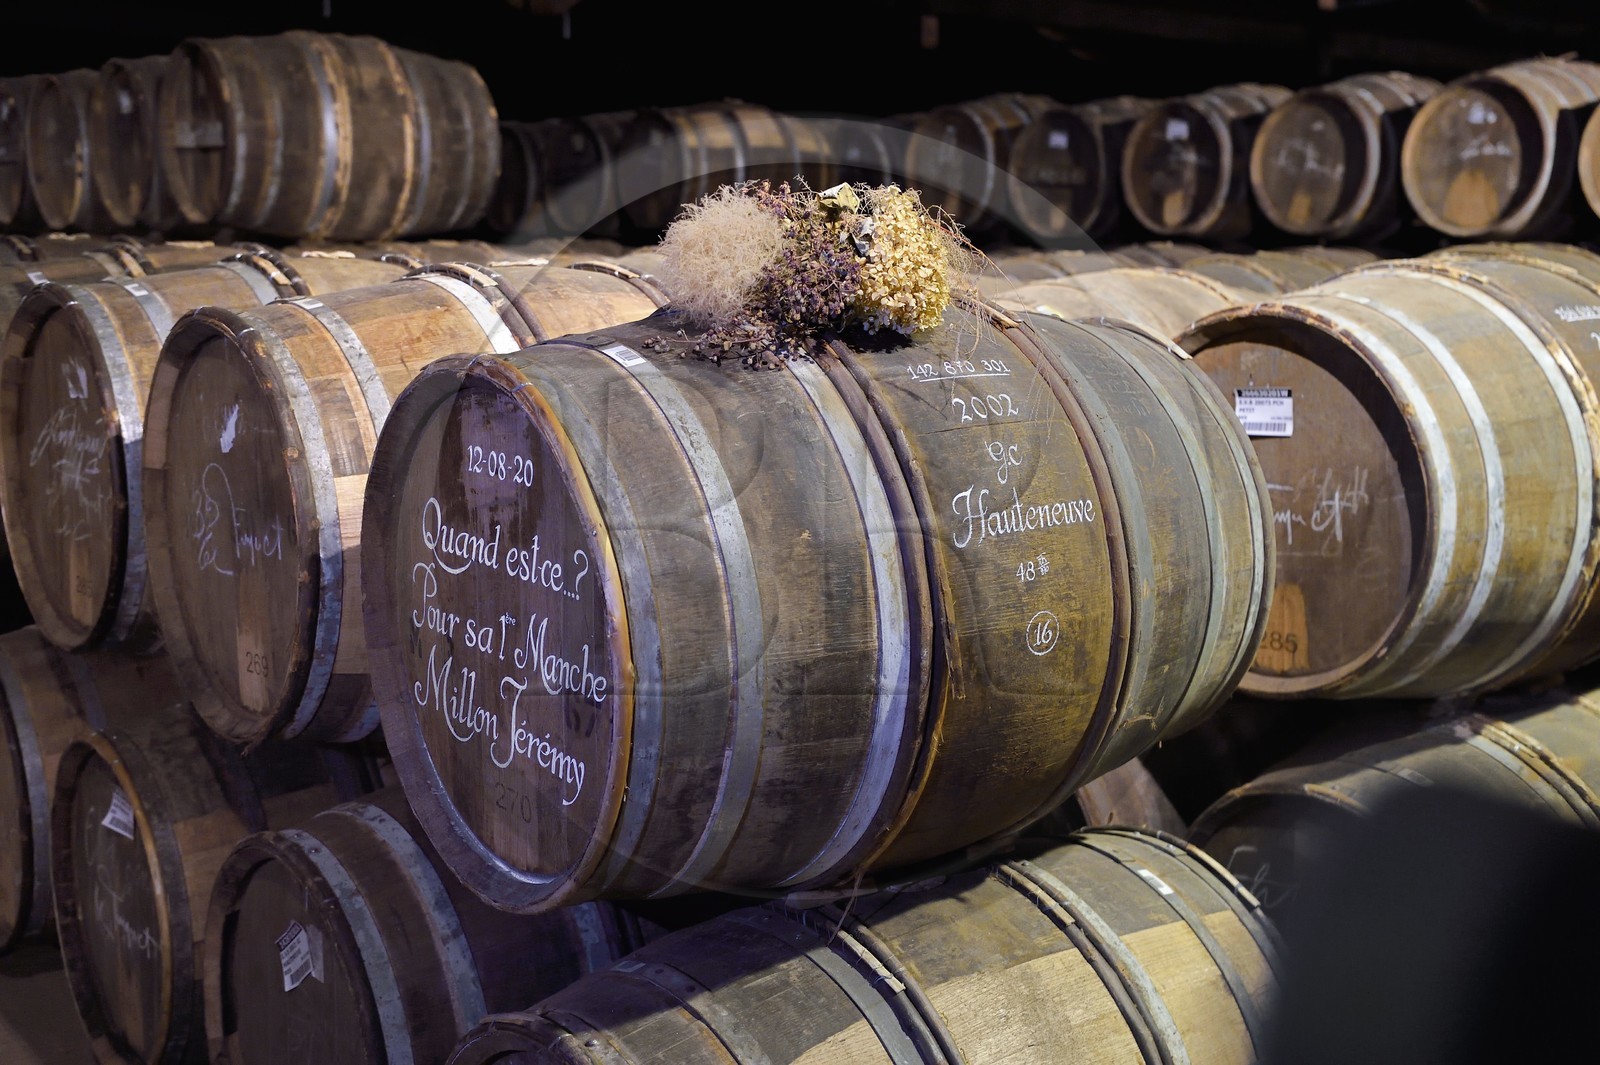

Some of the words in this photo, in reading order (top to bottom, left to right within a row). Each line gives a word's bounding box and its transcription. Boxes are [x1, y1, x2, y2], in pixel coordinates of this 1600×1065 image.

[907, 363, 938, 380] 142
[981, 359, 1011, 373] 301
[952, 393, 1019, 423] 2002
[467, 445, 534, 487] 12-08-20
[422, 497, 499, 574] Quand
[952, 484, 1096, 548] Hauteneuve
[412, 562, 460, 639] Pour
[464, 618, 494, 654] sa
[514, 613, 607, 702] Manche
[1033, 619, 1052, 646] 16
[246, 651, 269, 678] 269
[414, 644, 499, 742] Millon
[490, 677, 585, 806] Jérémy
[494, 781, 532, 824] 270
